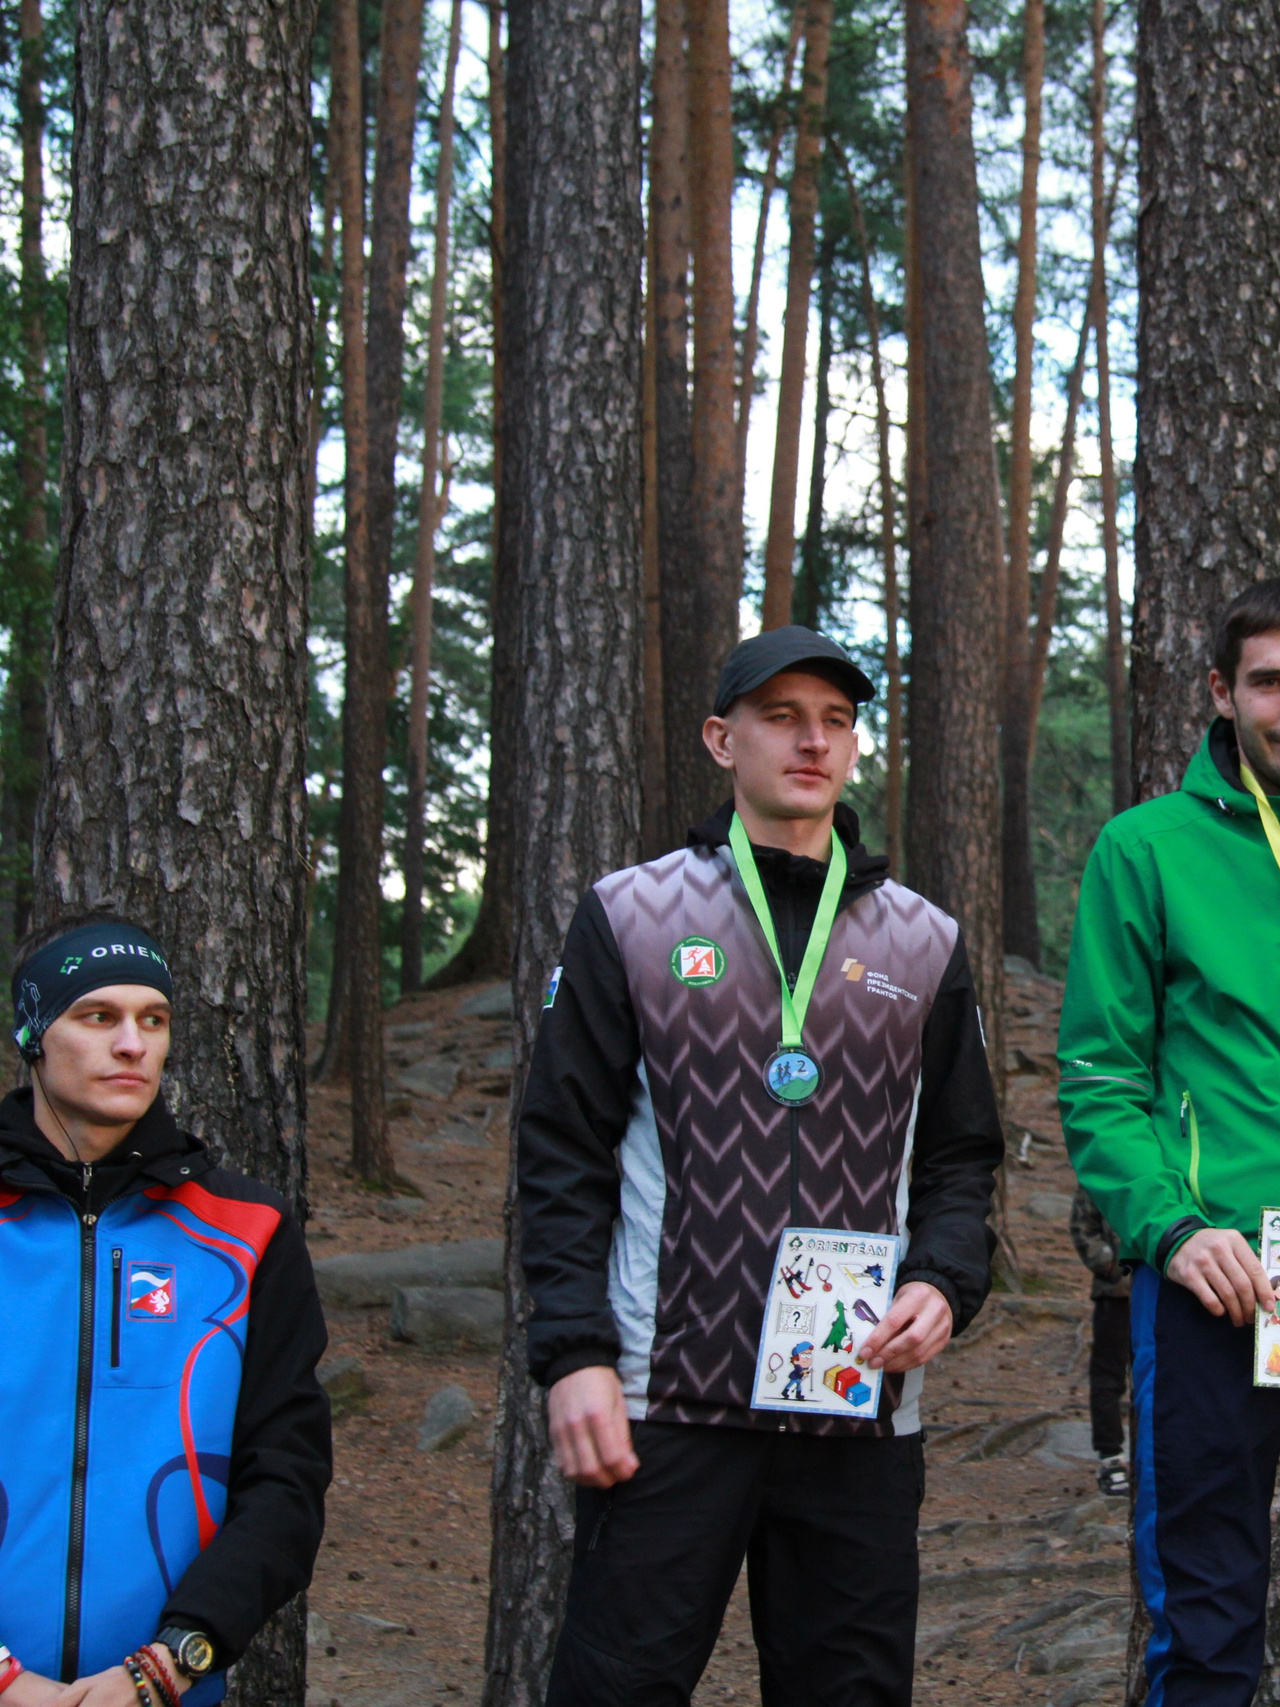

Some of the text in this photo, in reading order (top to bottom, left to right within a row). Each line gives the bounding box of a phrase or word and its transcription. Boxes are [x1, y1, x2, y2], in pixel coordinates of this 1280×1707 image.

[867, 971, 889, 982] ФОНД
[867, 978, 918, 1002] ПРЕЗИДЕНТСКИХ
[867, 986, 898, 1001] ГРАНТОВ
[796, 1060, 807, 1073] 2
[806, 1239, 888, 1257] ORIENTEAM
